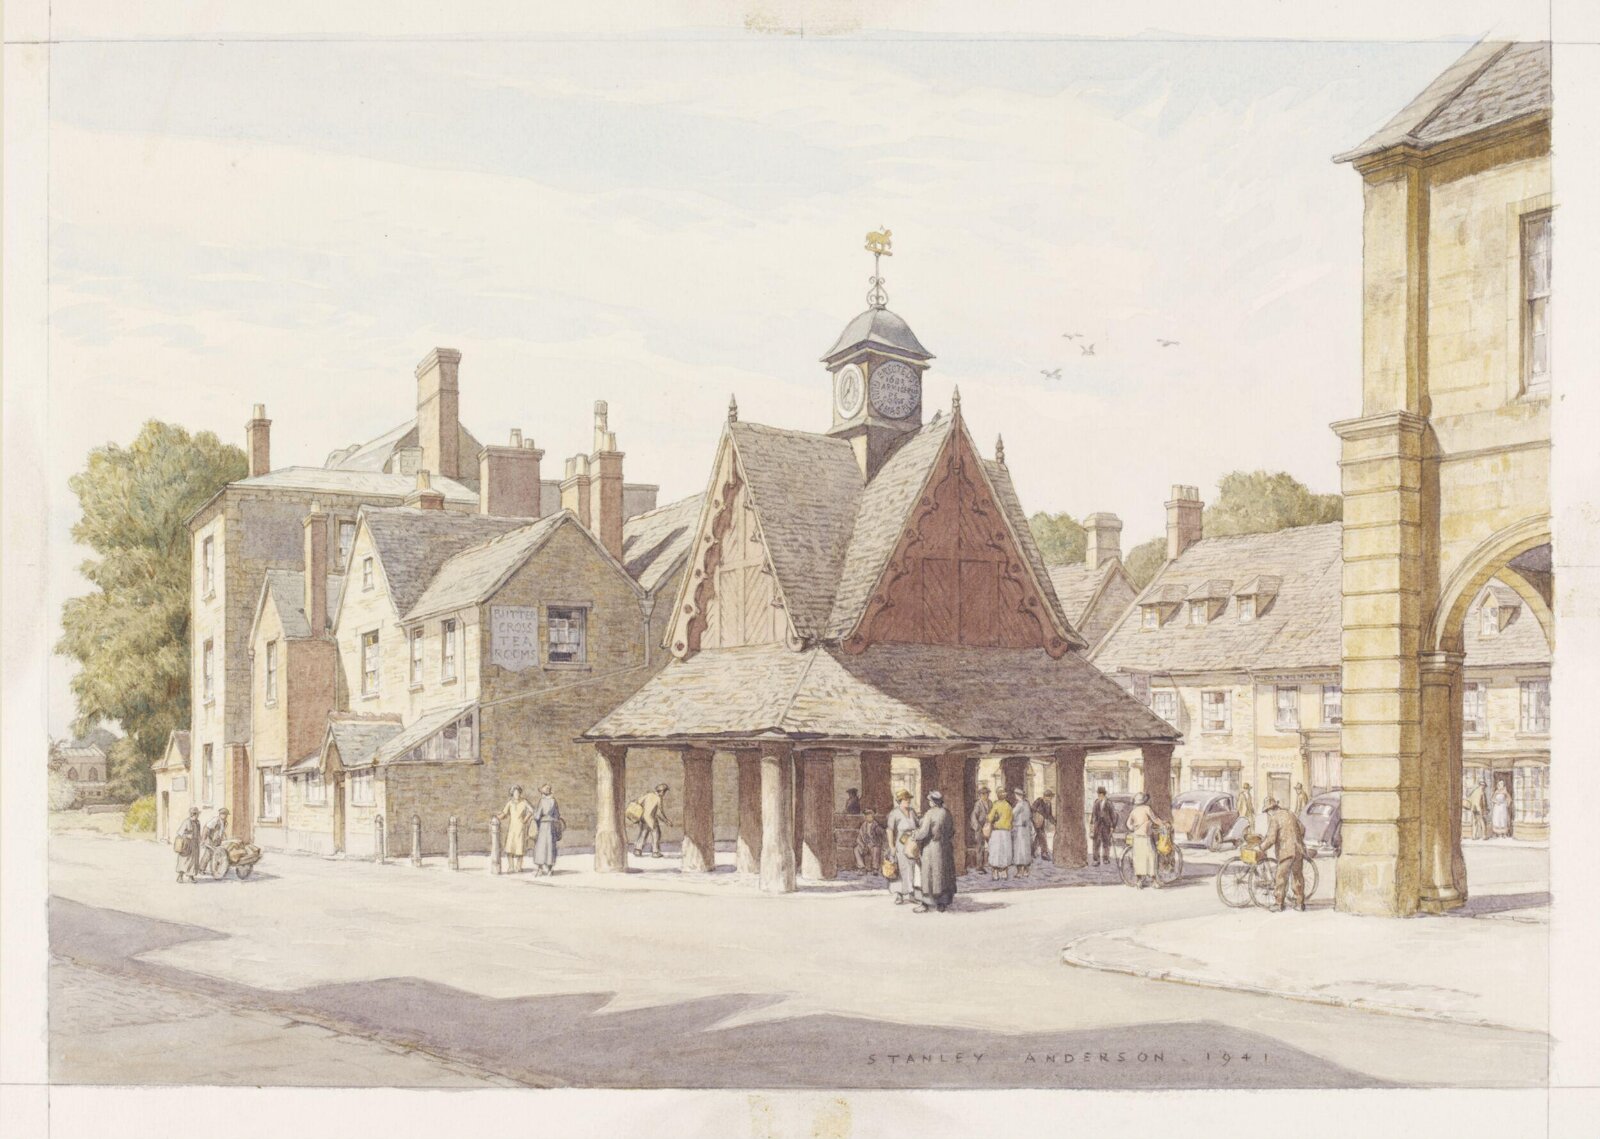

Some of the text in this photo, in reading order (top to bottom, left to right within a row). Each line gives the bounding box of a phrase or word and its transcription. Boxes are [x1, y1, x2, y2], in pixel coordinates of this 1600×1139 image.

[498, 622, 533, 633] CROSS
[499, 636, 533, 647] TEA
[494, 649, 537, 661] ROOMS
[867, 1052, 1268, 1067] STANLEY ANDERSON 1941
